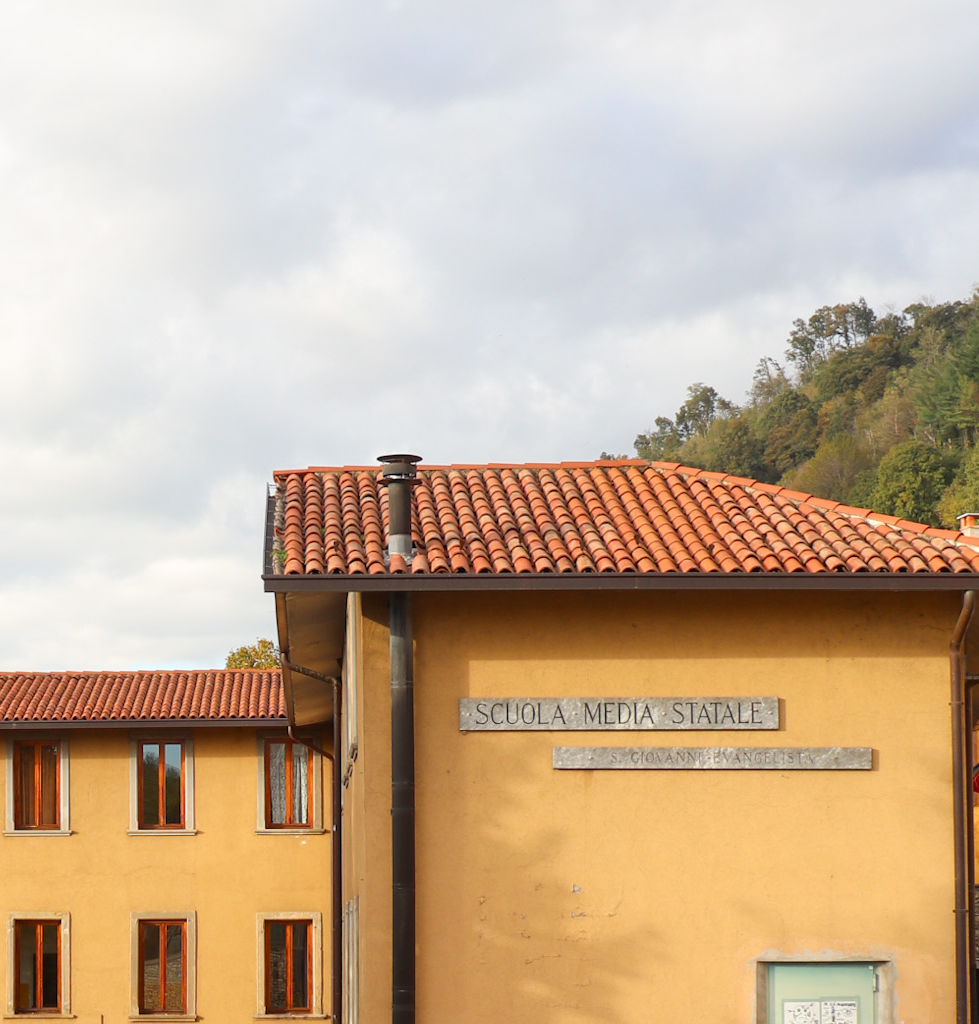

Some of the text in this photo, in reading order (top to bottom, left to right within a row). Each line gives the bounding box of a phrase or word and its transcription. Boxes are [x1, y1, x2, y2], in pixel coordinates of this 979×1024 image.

[475, 701, 763, 725] SCUOLA MEDIA STATALE
[610, 751, 816, 764] S. GIOVANNI EVANGELISTA
